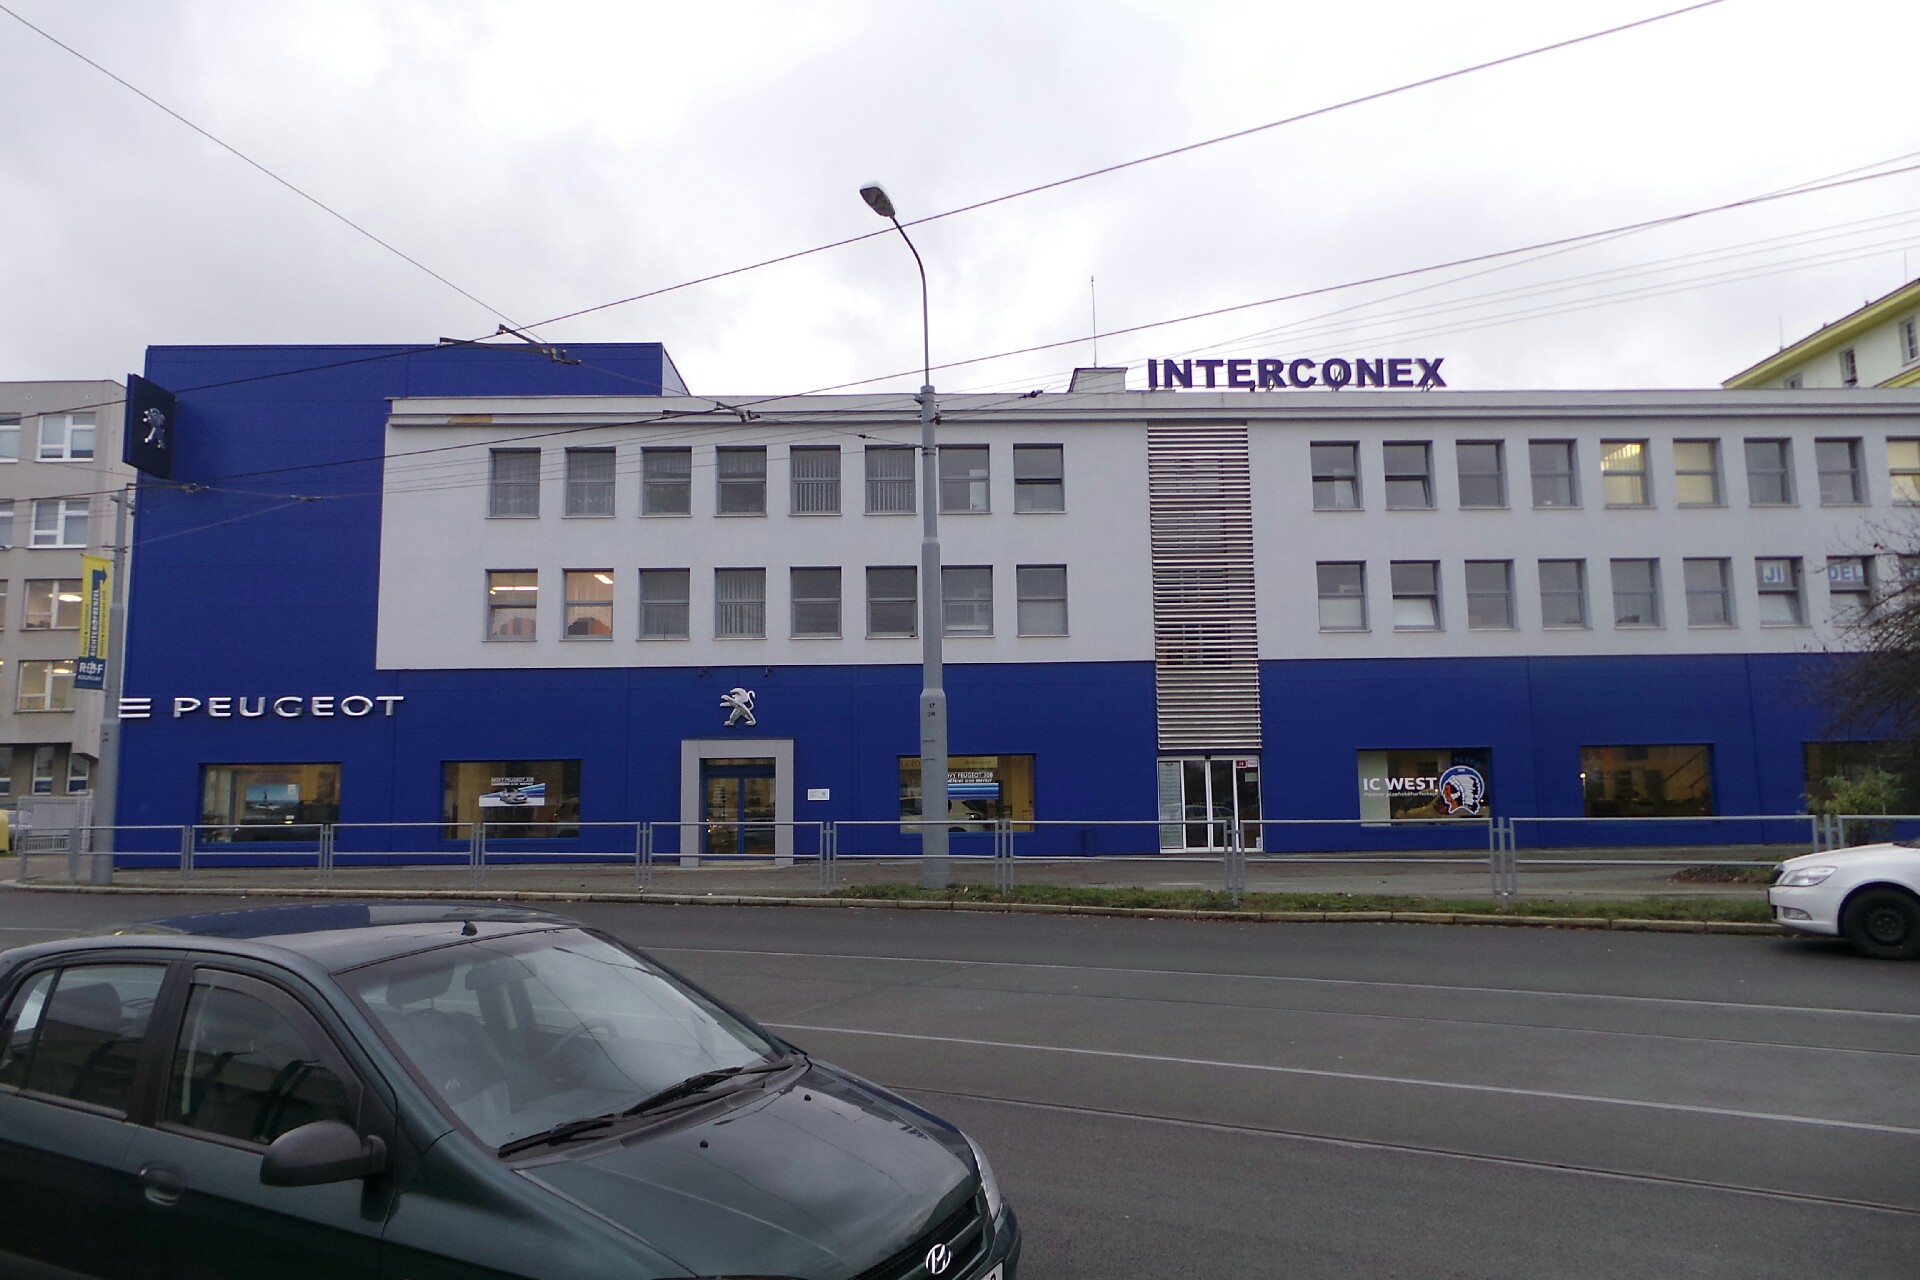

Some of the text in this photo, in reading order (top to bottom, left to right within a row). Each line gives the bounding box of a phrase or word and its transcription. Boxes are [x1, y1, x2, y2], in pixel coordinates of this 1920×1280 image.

[1148, 358, 1447, 388] INTERCONEX
[173, 696, 404, 718] PEUGEOT
[1363, 777, 1438, 790] IC WEST
